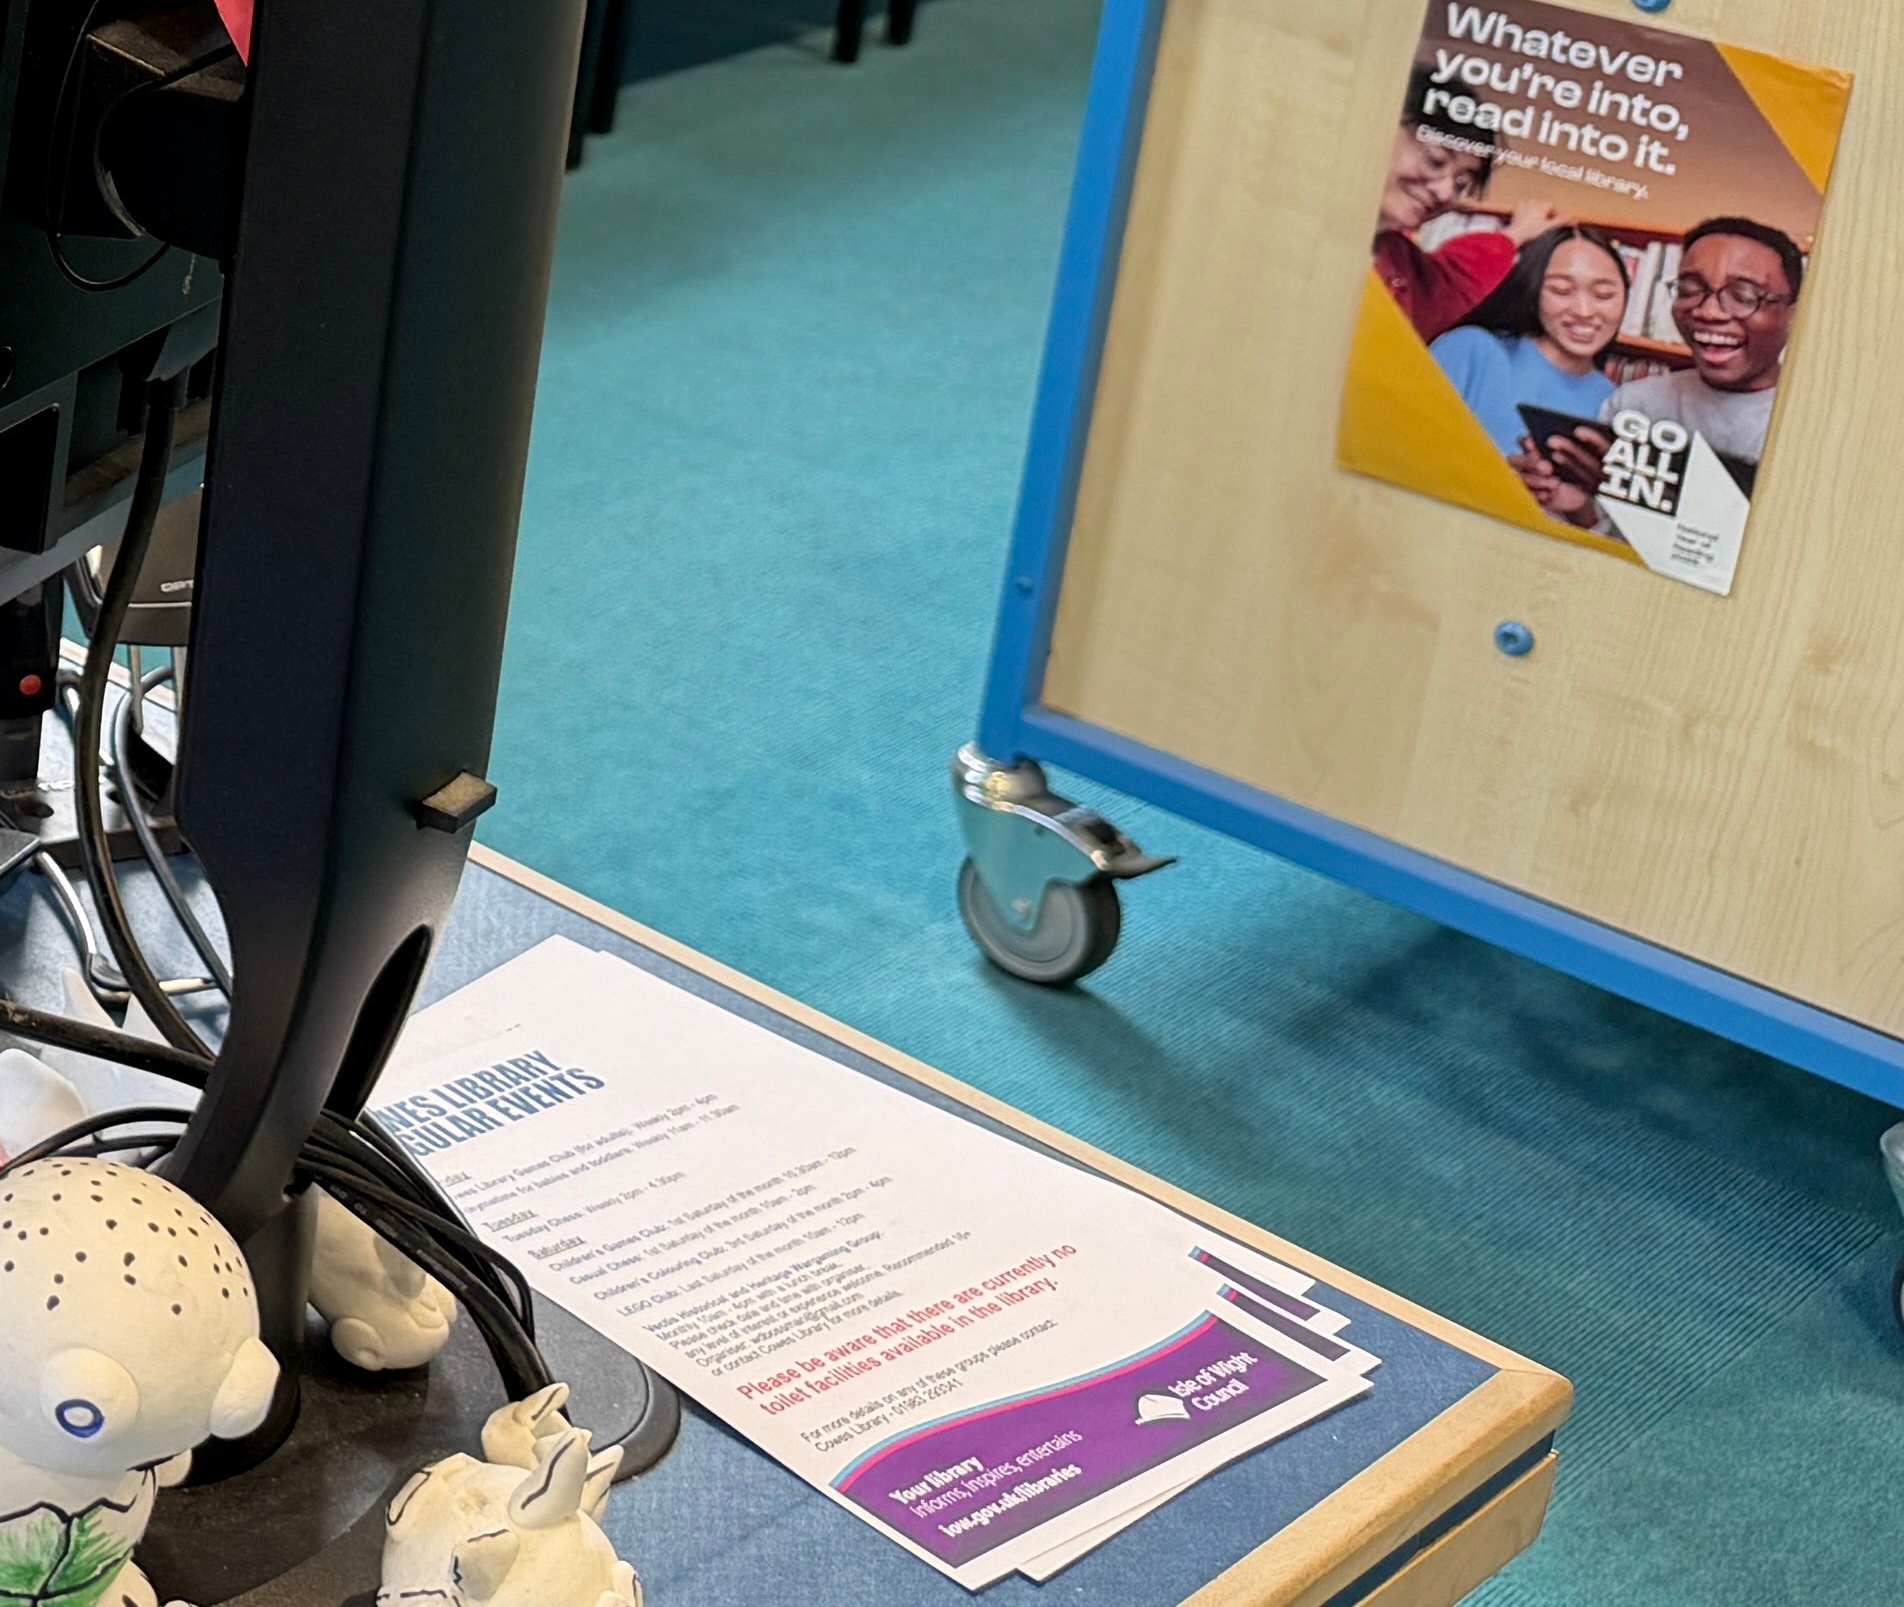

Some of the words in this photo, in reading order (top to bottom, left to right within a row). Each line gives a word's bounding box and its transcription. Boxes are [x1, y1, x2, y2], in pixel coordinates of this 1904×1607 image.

[1447, 2, 1683, 88] Whatever
[1430, 49, 1583, 109] you're
[1586, 81, 1690, 142] into,
[1415, 124, 1494, 158] Discover
[1495, 145, 1540, 169] your
[1540, 156, 1585, 181] local
[1422, 88, 1535, 140] read
[1537, 110, 1629, 163] into
[1632, 136, 1677, 176] it.
[1612, 409, 1688, 453] GO
[1602, 438, 1680, 484] ALL
[1598, 465, 1672, 512] IN.
[431, 1049, 563, 1110] LIBRARY
[494, 1067, 606, 1125] EVENTS
[735, 1368, 803, 1399] Please
[794, 1357, 828, 1373] be
[822, 1334, 879, 1362] aware
[868, 1316, 914, 1340] that
[903, 1299, 957, 1324] there
[951, 1287, 986, 1304] are
[979, 1255, 1061, 1292] currently
[1050, 1245, 1081, 1260] no
[755, 1385, 812, 1415] toilet
[802, 1356, 883, 1393] facilities
[877, 1323, 957, 1361] available
[947, 1314, 976, 1328] in
[966, 1302, 1004, 1319] the
[994, 1277, 1060, 1307] library.
[1204, 1349, 1258, 1377] Wight
[1164, 1378, 1203, 1397] Isle
[1187, 1377, 1251, 1411] Council
[1192, 1368, 1219, 1385] of
[797, 1429, 824, 1441] For
[821, 1416, 851, 1432] more
[844, 1401, 885, 1420] details
[811, 1431, 855, 1452] Cowes
[847, 1414, 894, 1435] Library
[887, 1481, 934, 1504] Your
[923, 1457, 989, 1487] library
[907, 1487, 973, 1518] Informs,
[959, 1462, 1025, 1492] inspires,
[1015, 1431, 1085, 1467] entertains
